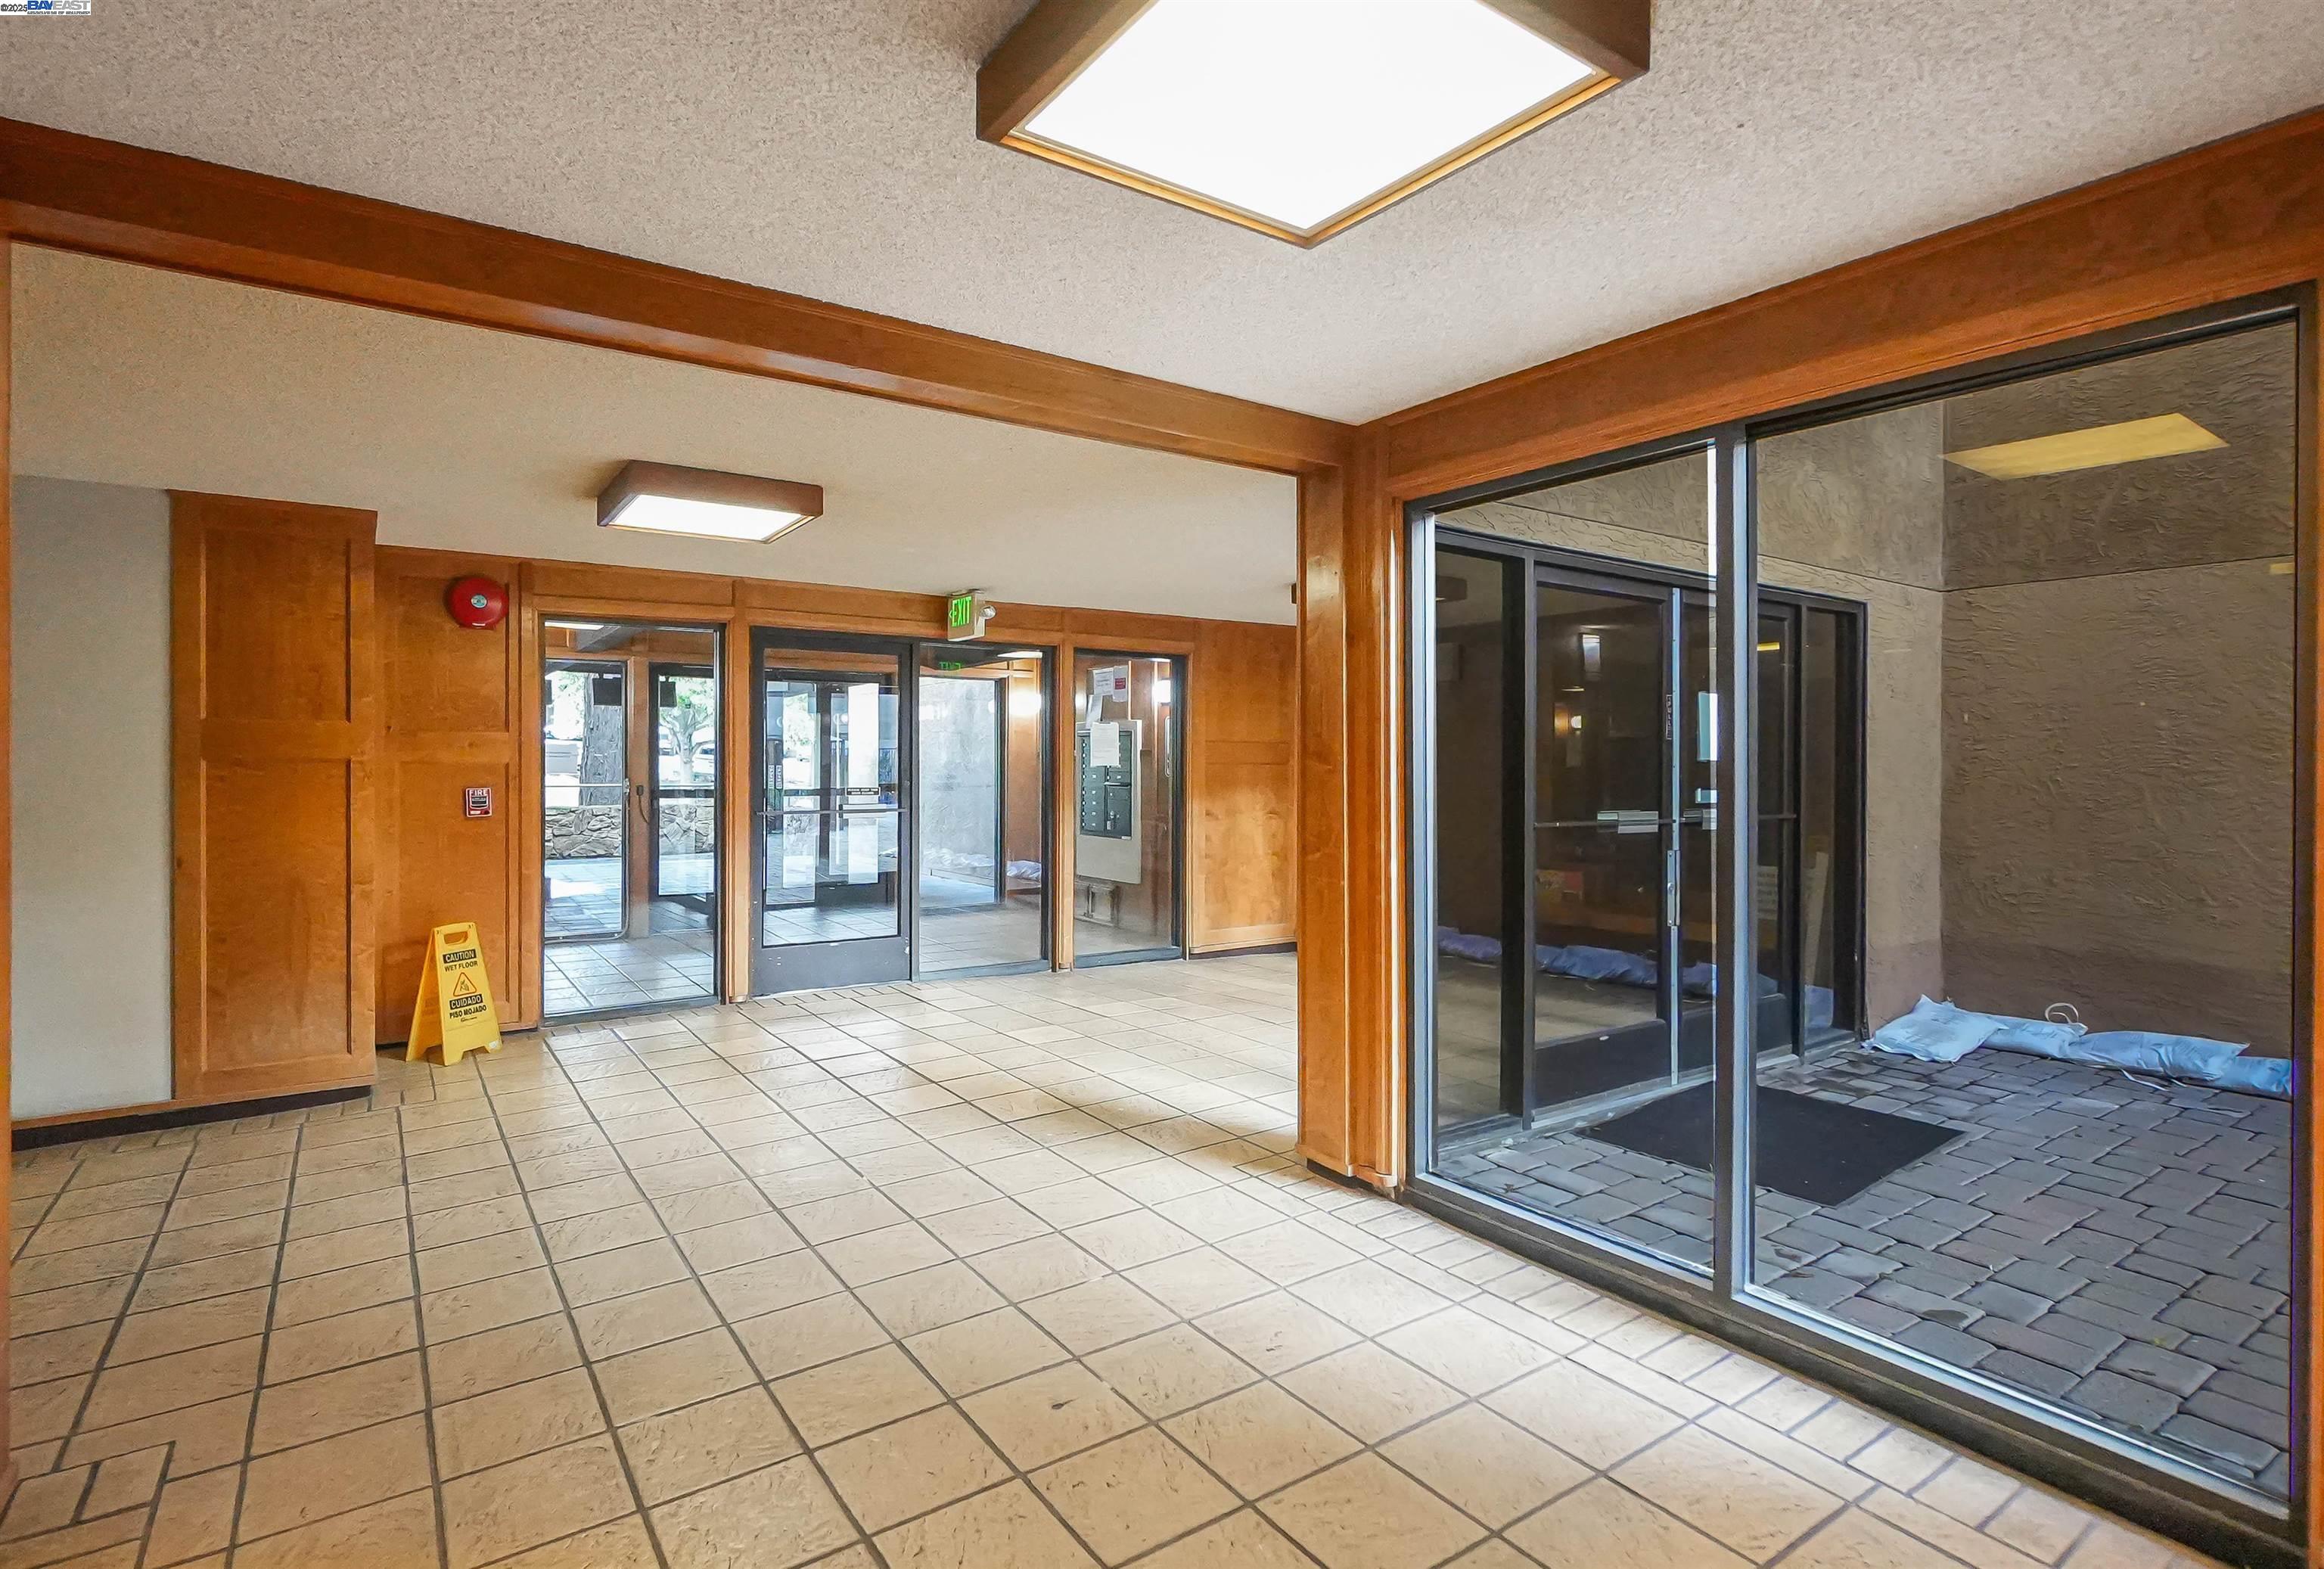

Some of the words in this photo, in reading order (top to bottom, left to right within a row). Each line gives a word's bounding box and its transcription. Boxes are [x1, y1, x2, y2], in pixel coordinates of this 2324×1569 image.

[952, 596, 971, 626] EXIT
[446, 950, 474, 962] CAUTION
[458, 961, 478, 969] FLOOR
[451, 995, 481, 1008] CUIDADO
[449, 1010, 463, 1019] PISO
[463, 1005, 487, 1015] MOJADO
